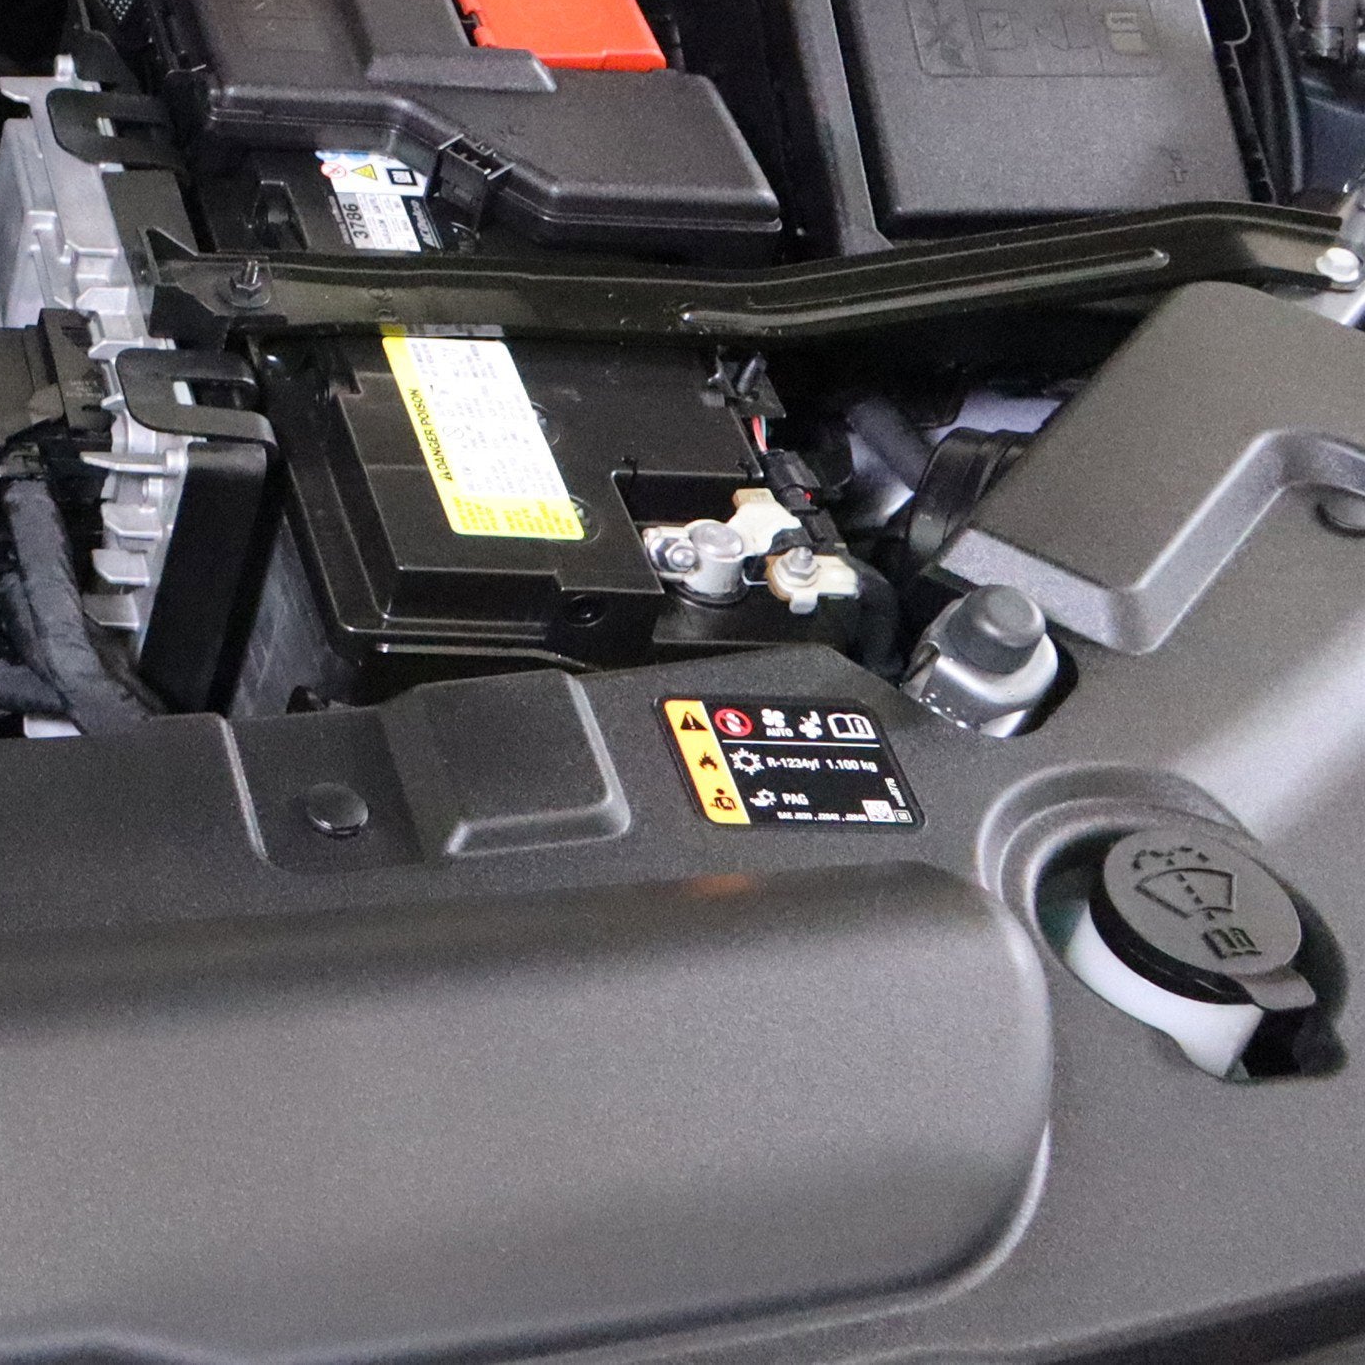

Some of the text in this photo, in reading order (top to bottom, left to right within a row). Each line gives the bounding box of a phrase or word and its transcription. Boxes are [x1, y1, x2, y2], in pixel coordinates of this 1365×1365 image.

[342, 203, 369, 239] 3786
[409, 388, 448, 475] DANGER POISON
[766, 727, 794, 738] AUTO
[860, 759, 879, 773] kg
[781, 793, 810, 805] PAG
